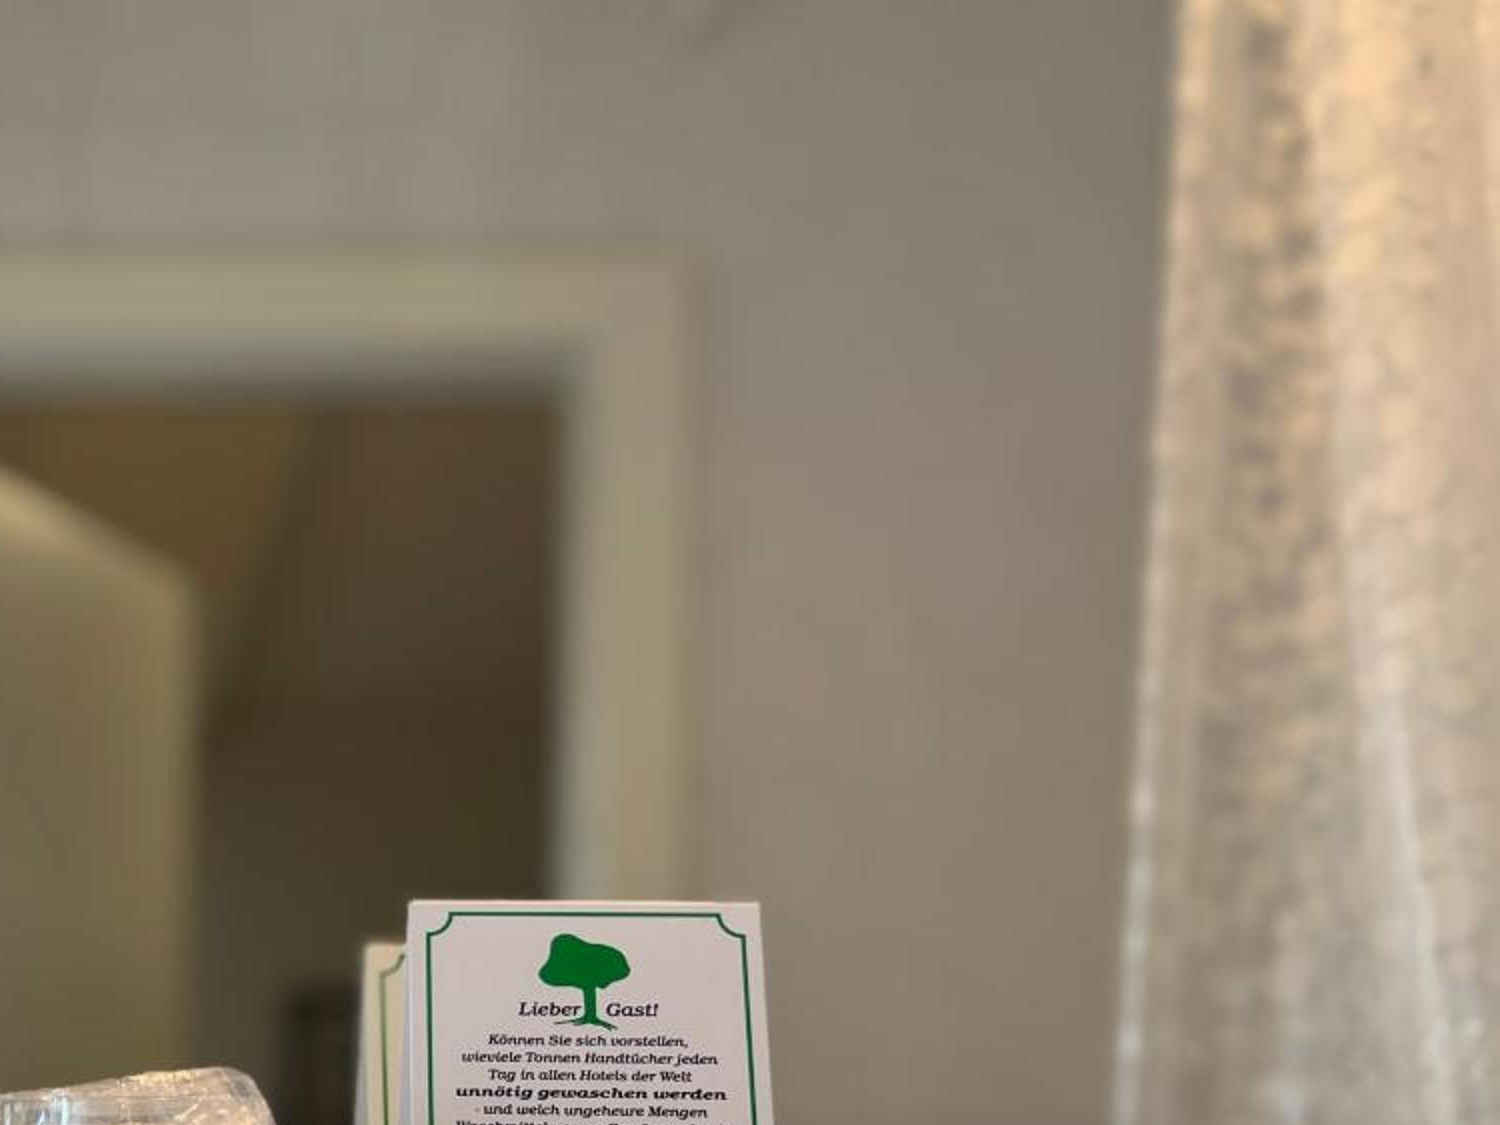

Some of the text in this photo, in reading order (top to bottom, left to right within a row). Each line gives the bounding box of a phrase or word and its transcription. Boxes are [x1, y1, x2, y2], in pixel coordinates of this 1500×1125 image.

[518, 1001, 660, 1017] Lieber Gast!
[488, 1034, 545, 1046] Können
[548, 1035, 572, 1046] Sie
[575, 1035, 607, 1047] sich
[525, 1051, 581, 1063] Tonnen
[674, 1053, 718, 1067] jeden
[487, 1068, 517, 1083] Tag
[520, 1069, 536, 1081] in
[538, 1069, 577, 1081] allen
[631, 1070, 657, 1082] der
[659, 1071, 692, 1083] Welt
[456, 1085, 727, 1101] unnötig gewaschen werden
[483, 1104, 513, 1115] und
[563, 1105, 645, 1119] ungeheure
[648, 1106, 708, 1121] Mengen
